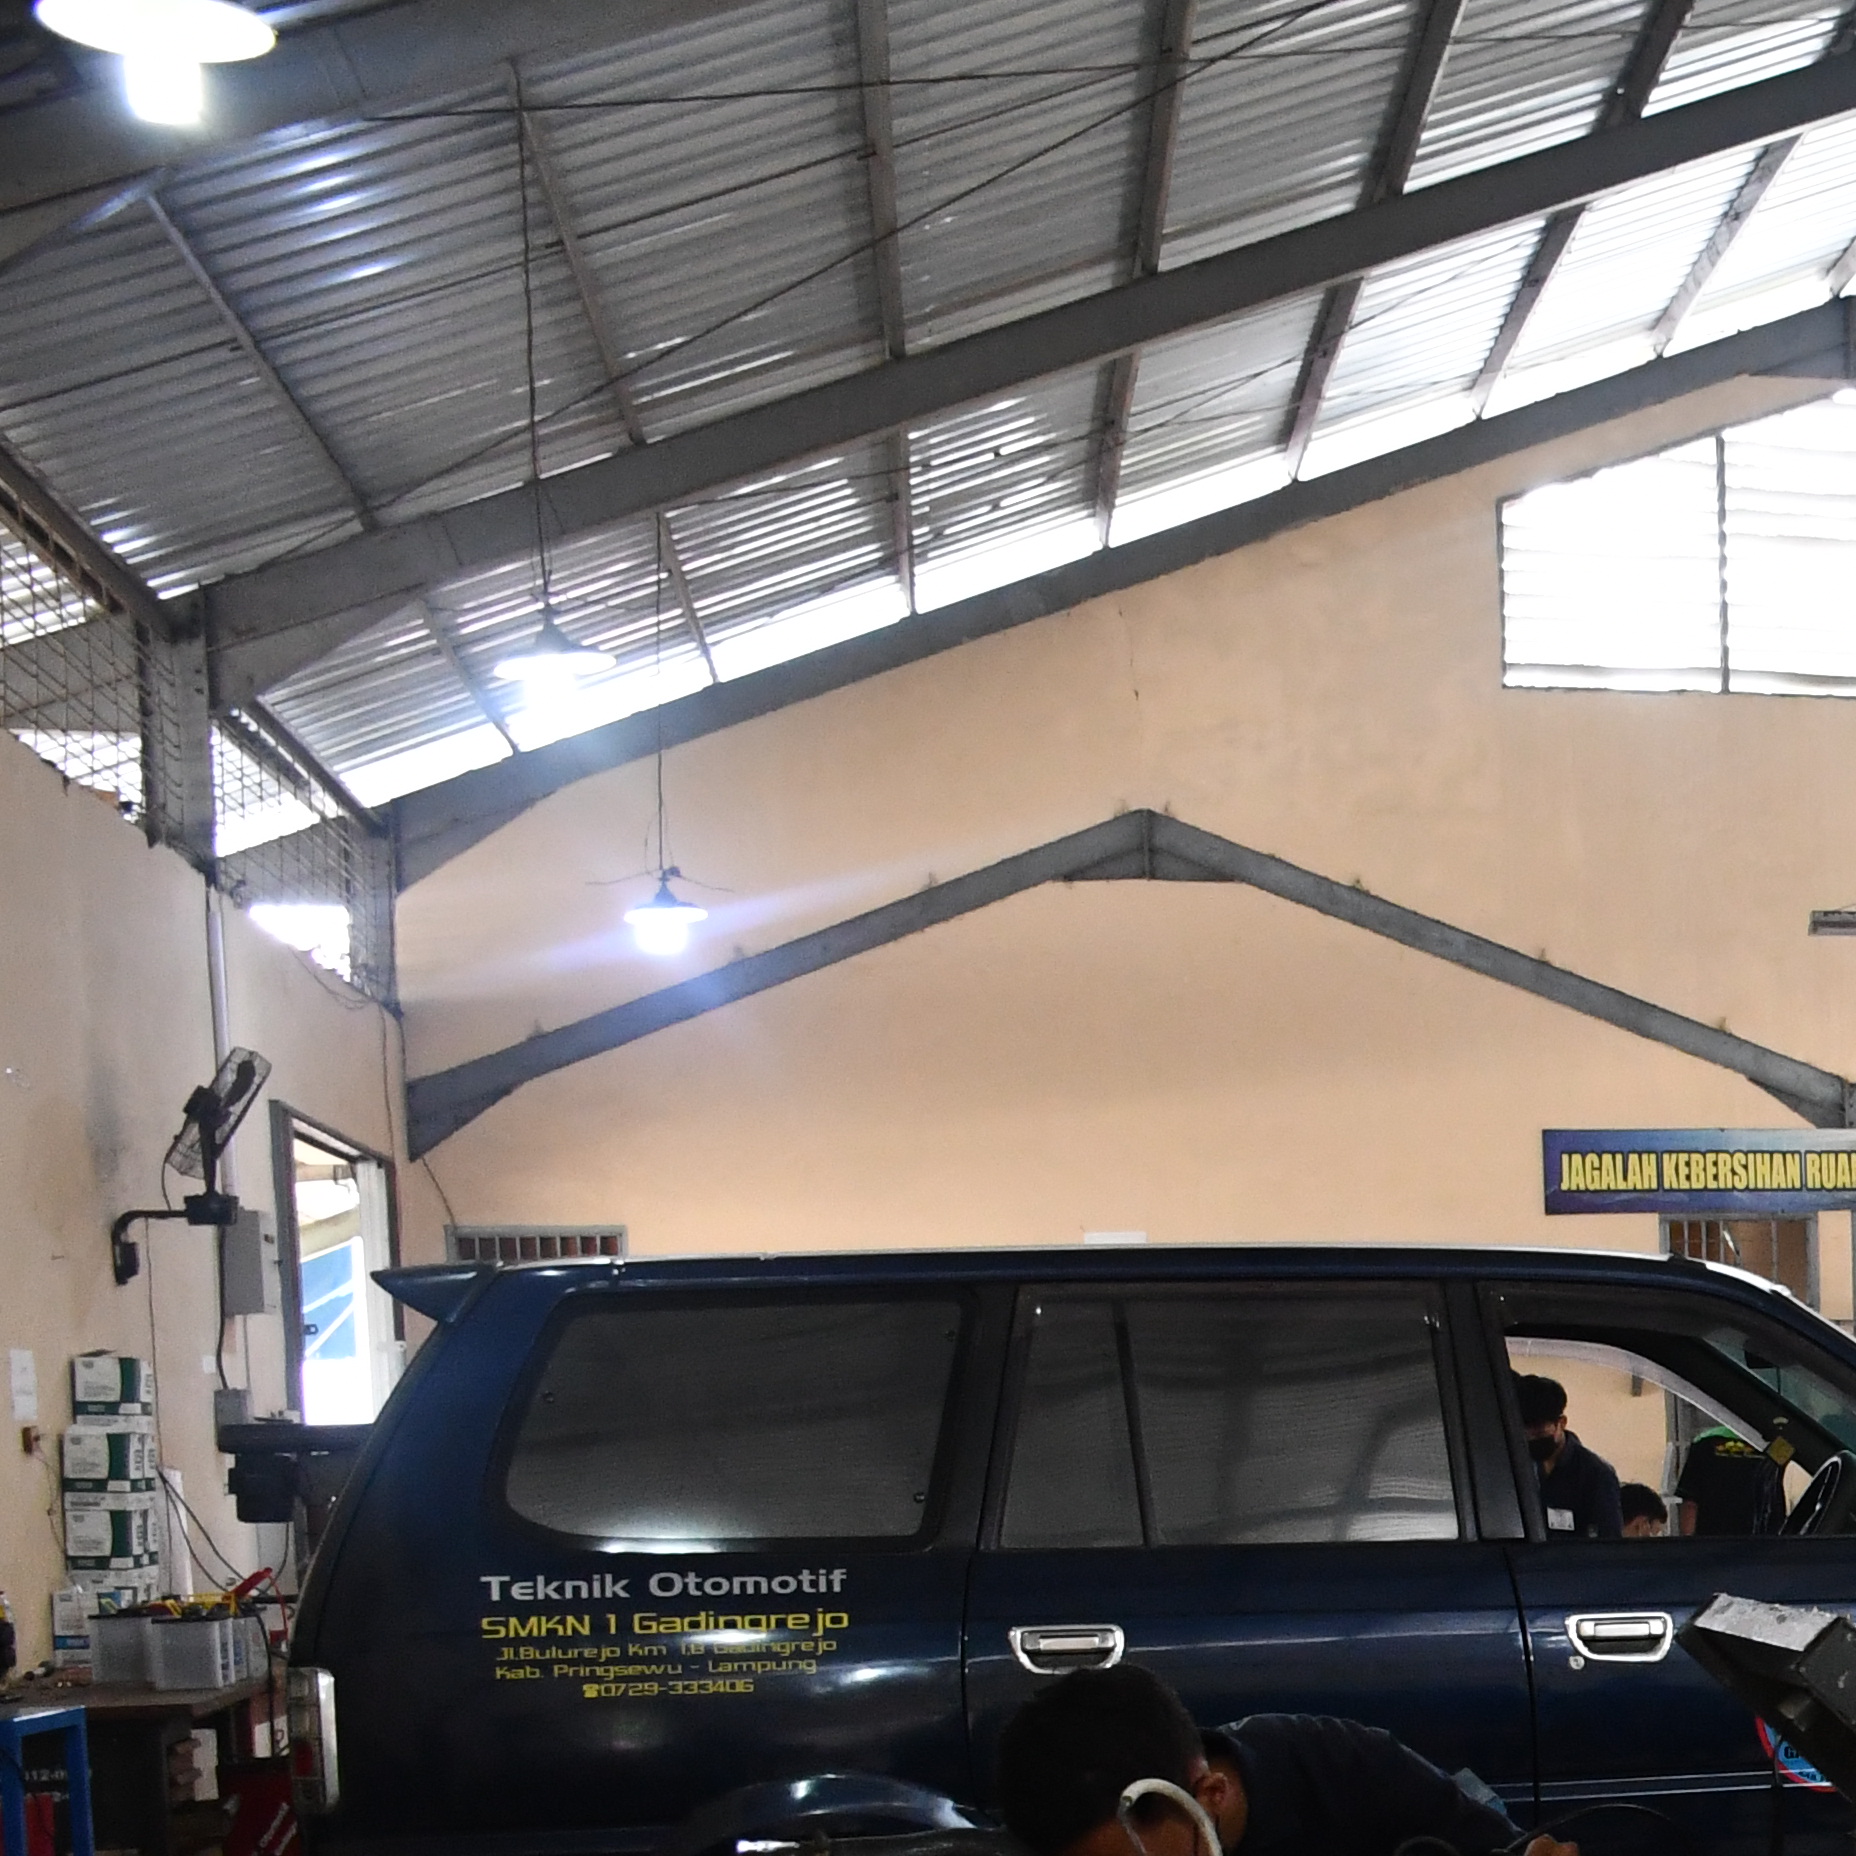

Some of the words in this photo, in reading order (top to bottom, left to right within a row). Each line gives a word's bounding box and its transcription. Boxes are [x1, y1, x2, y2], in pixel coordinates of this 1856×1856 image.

[1561, 1151, 1658, 1191] JAGALAH
[1662, 1150, 1801, 1190] KEBERSIHAN
[480, 1573, 630, 1602] Teknik
[649, 1568, 848, 1597] Otomotif
[480, 1615, 591, 1639] SMKN
[606, 1613, 618, 1635] 1
[632, 1609, 850, 1637] Gadingrejo
[629, 1643, 667, 1657] Km
[495, 1666, 544, 1681] Kab.
[553, 1661, 684, 1681] Pringsewu
[707, 1658, 819, 1676] Lampung
